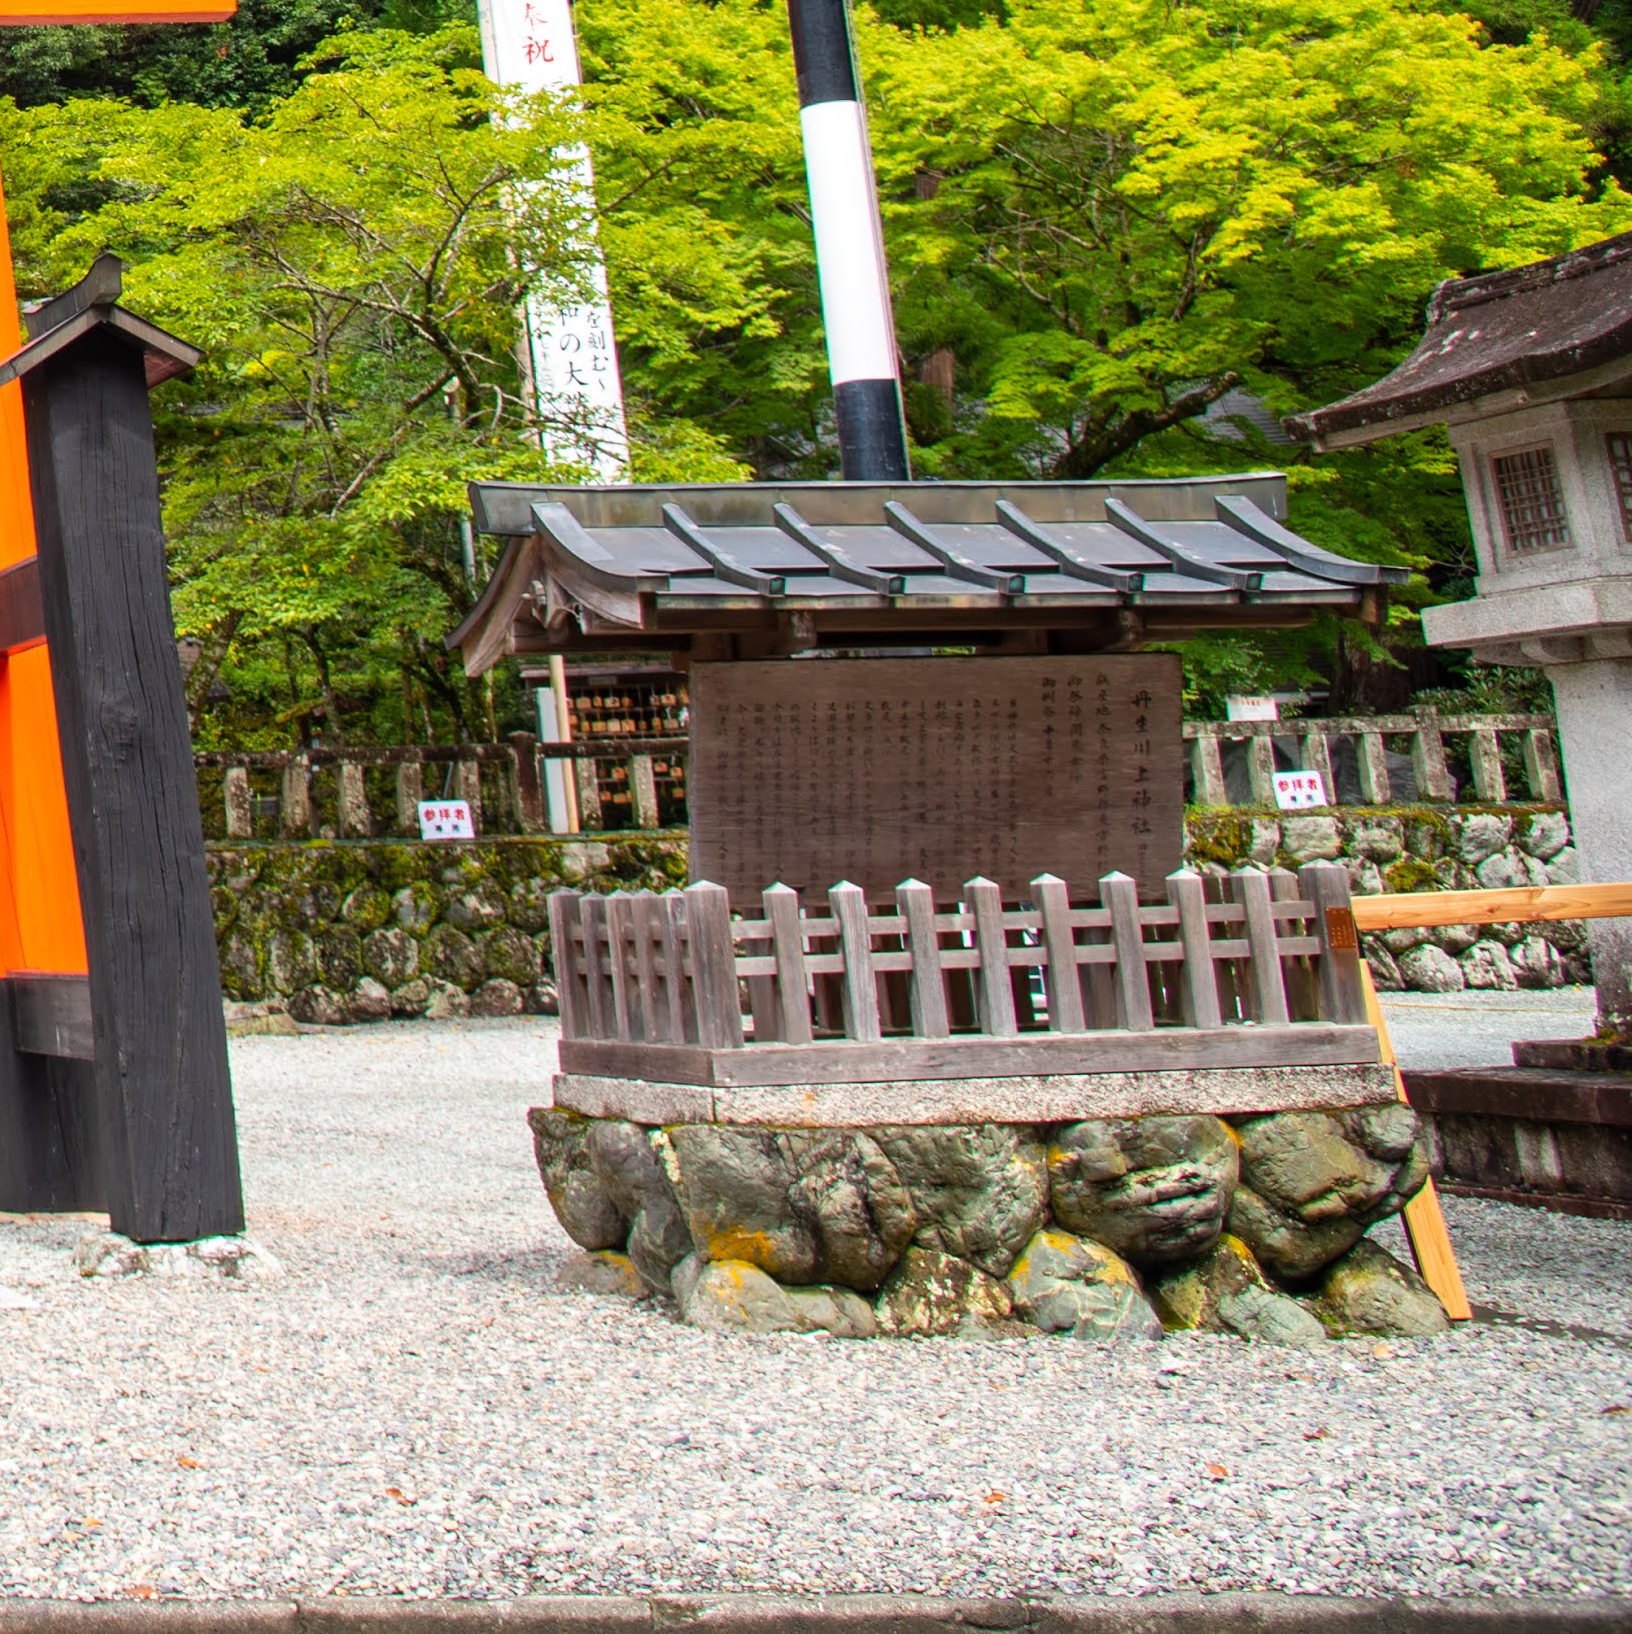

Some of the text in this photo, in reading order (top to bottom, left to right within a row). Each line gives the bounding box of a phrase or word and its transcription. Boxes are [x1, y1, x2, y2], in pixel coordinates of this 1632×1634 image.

[522, 3, 555, 65] 奉祝
[1130, 689, 1154, 835] 丹生川上神社
[1278, 778, 1318, 793] 参拝者
[424, 807, 465, 822] 参拝者
